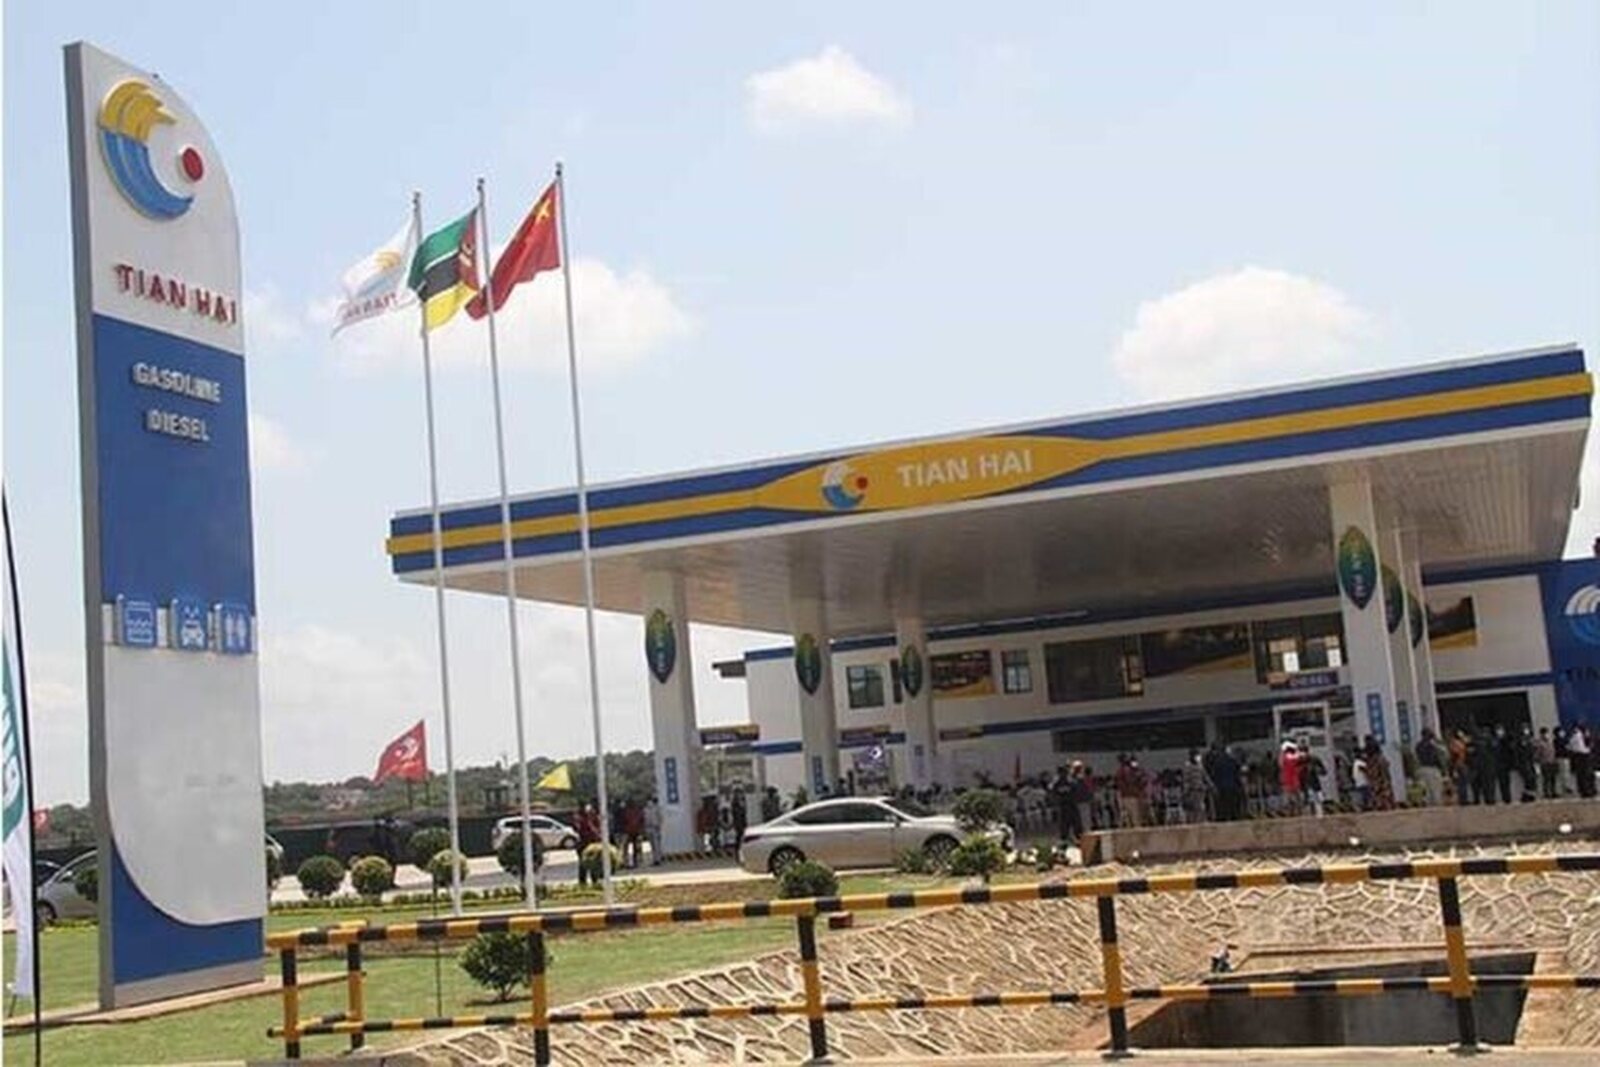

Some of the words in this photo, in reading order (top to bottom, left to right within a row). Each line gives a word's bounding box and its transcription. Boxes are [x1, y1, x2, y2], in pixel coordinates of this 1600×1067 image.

[115, 264, 187, 307] TIAN
[196, 288, 237, 323] HAI
[134, 363, 221, 402] GASOLINE
[148, 410, 210, 441] DIESEL
[899, 459, 968, 487] TIAN
[981, 450, 1032, 478] HAI
